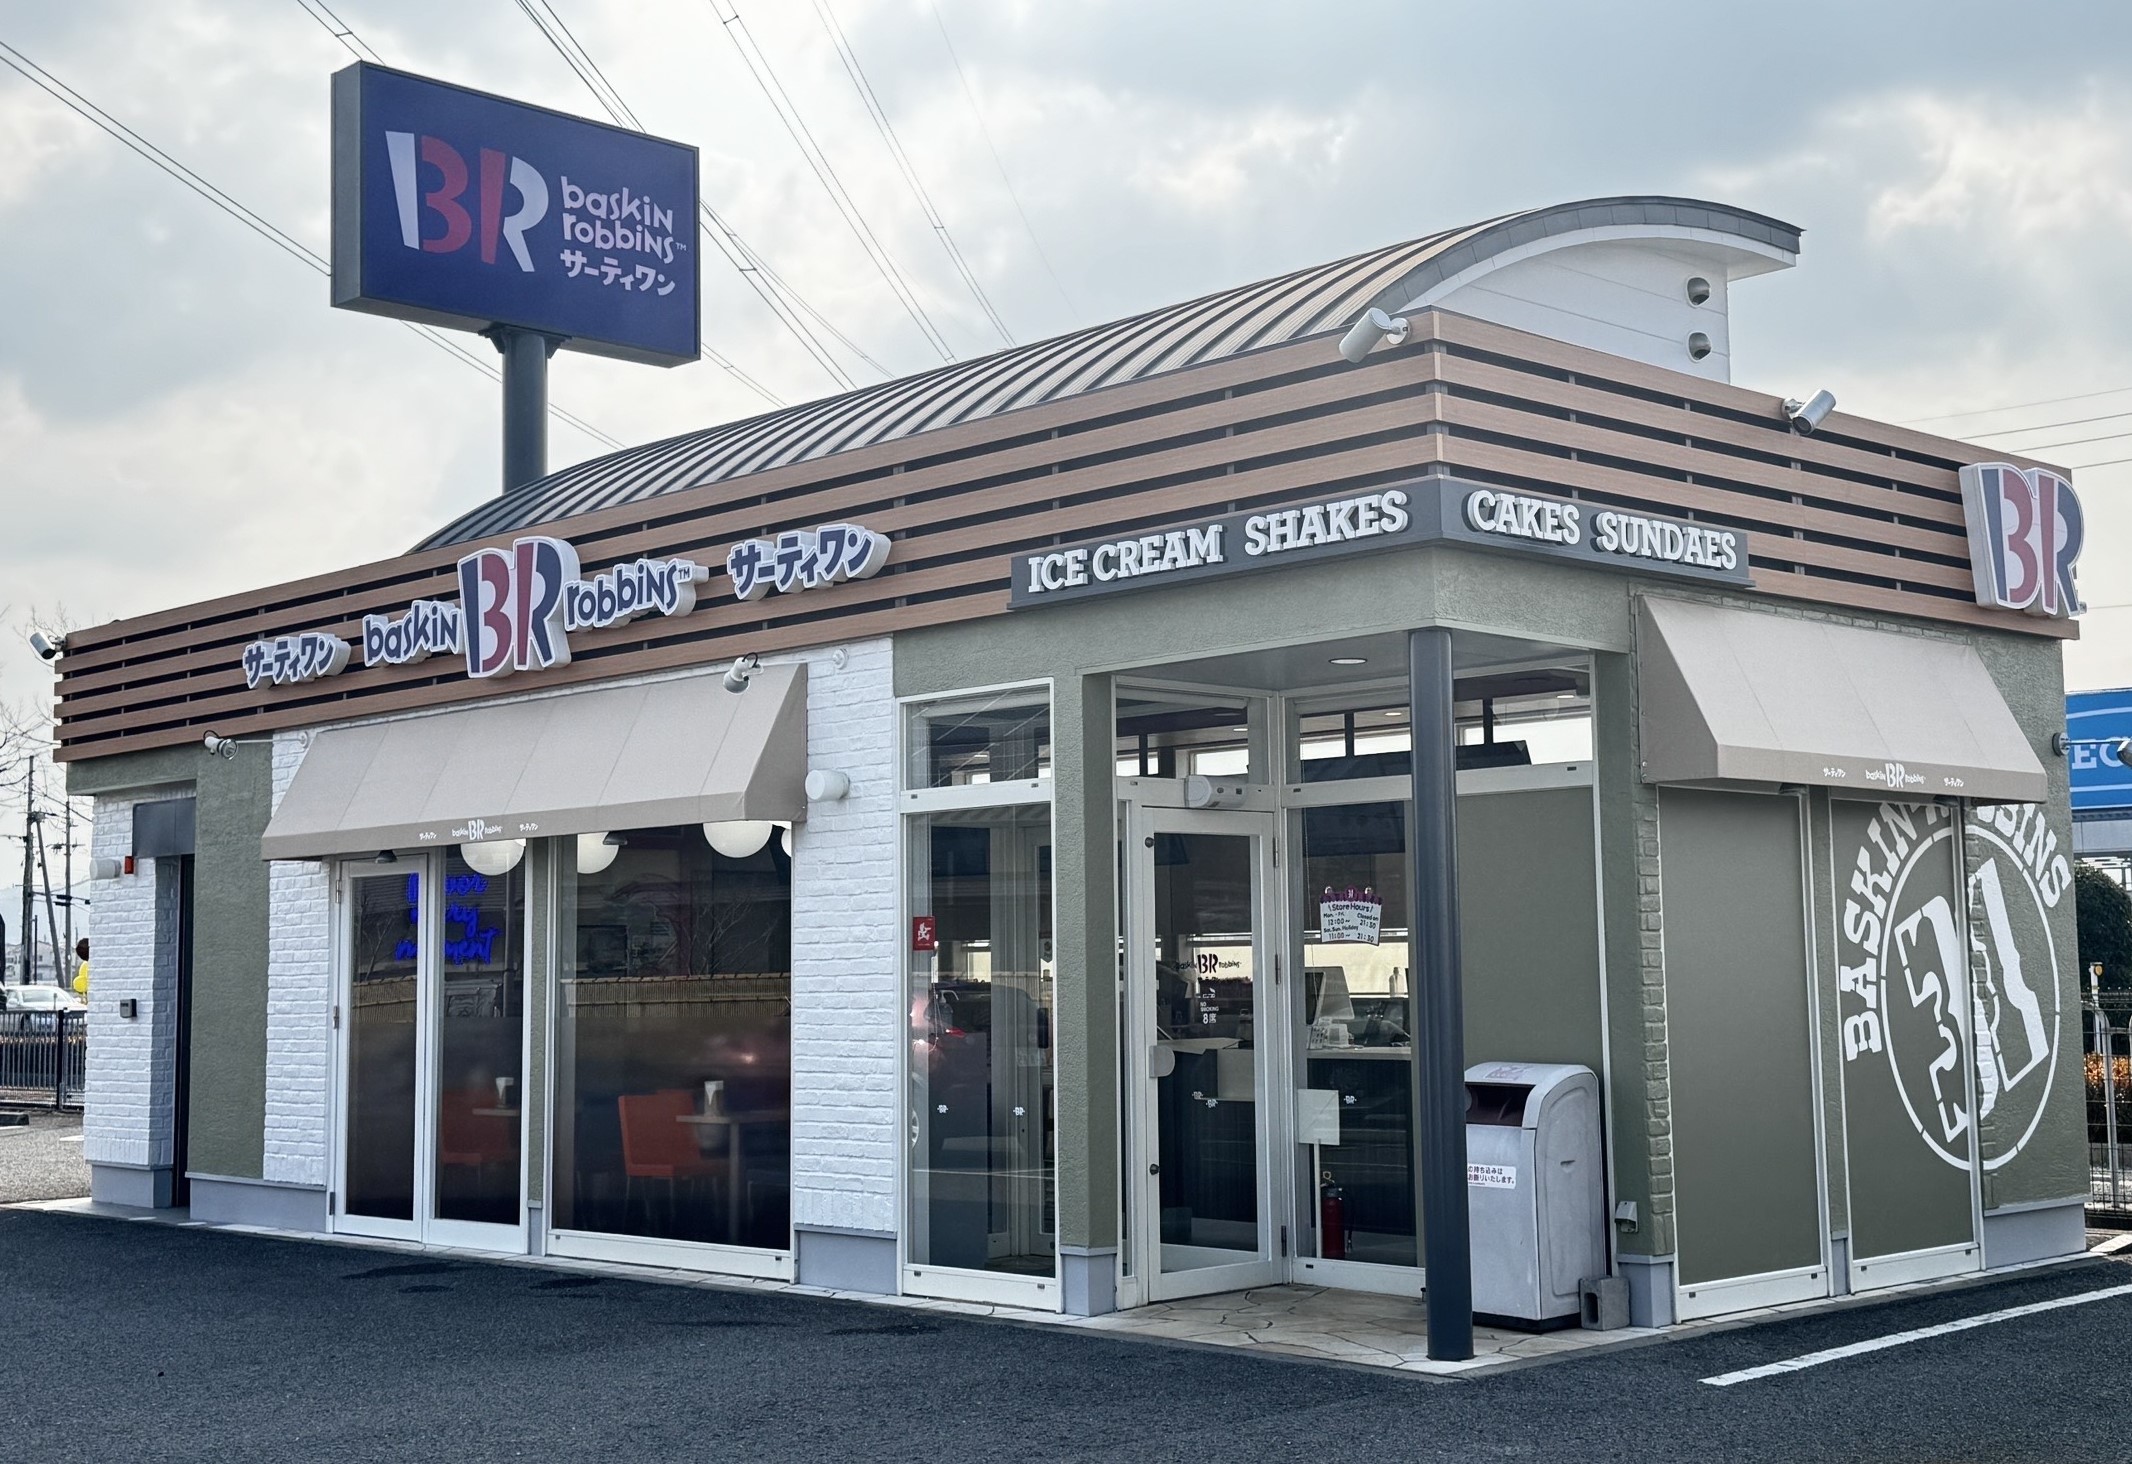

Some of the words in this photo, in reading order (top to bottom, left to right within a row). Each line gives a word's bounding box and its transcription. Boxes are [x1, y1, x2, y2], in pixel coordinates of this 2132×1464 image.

[385, 130, 549, 273] BR
[560, 175, 673, 234] baskin
[560, 249, 676, 296] サーティワン
[1028, 549, 1088, 593] ICE
[1093, 524, 1224, 581] CREAM
[1245, 489, 1409, 555] SHAKES
[1468, 489, 1581, 545] CAKES
[1596, 511, 1737, 570] SUNDAES
[1981, 467, 2082, 612] BR
[730, 528, 872, 595] サーティワン
[366, 604, 458, 663] baskin
[461, 541, 563, 674] BR
[244, 635, 334, 686] サーティワン
[1885, 762, 1905, 788] BR
[468, 818, 485, 840] BR
[1332, 903, 1349, 912] Store
[1350, 903, 1370, 912] Hours
[1197, 953, 1218, 974] BR
